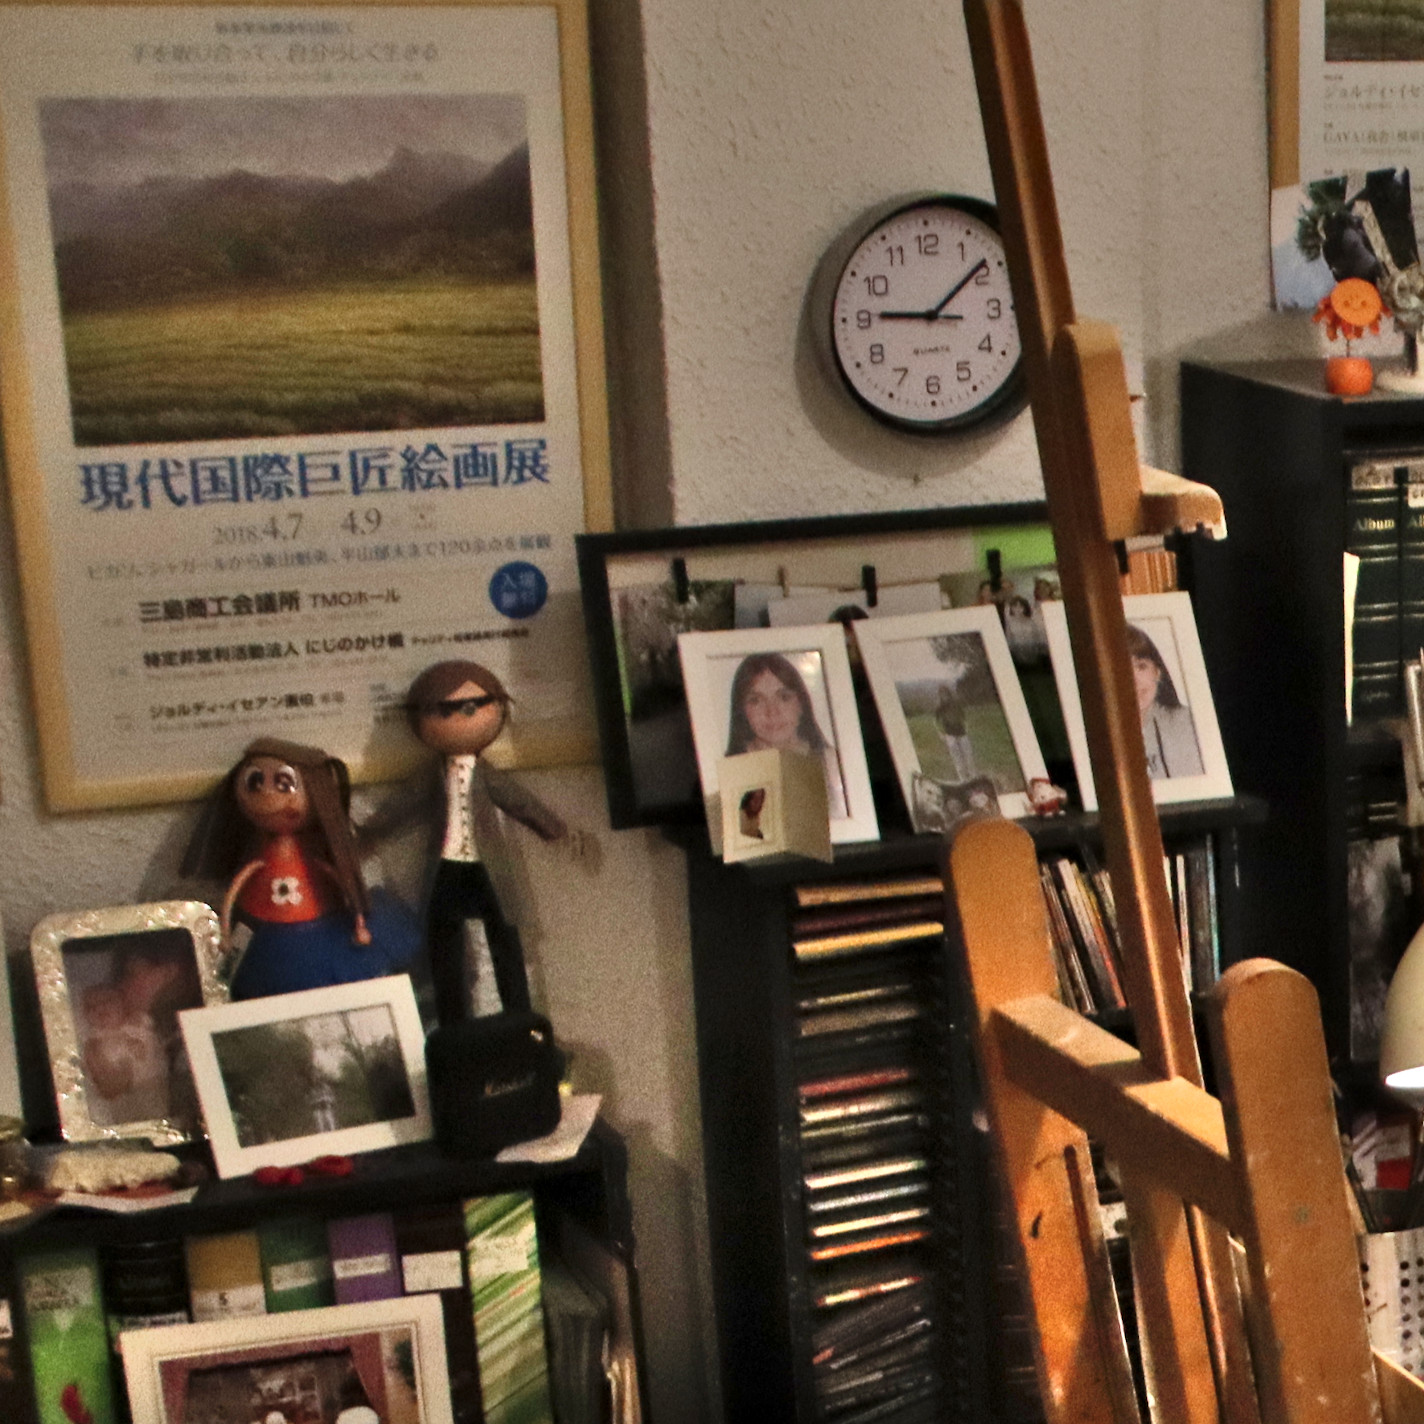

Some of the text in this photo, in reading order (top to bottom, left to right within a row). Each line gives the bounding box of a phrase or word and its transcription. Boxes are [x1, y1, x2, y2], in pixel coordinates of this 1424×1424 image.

[914, 234, 939, 255] 12
[956, 241, 966, 261] 1
[886, 245, 905, 266] 11
[974, 262, 991, 285] 2
[864, 275, 888, 296] 10
[856, 309, 872, 329] 9
[986, 297, 1001, 320] 3
[869, 343, 885, 364] 8
[977, 333, 993, 353] 4
[892, 367, 909, 386] 7
[956, 360, 972, 382] 5
[925, 375, 941, 395] 6
[80, 438, 550, 512] 現代国際巨匠絵画展
[340, 506, 383, 535] 4.9
[1354, 515, 1396, 532] Album
